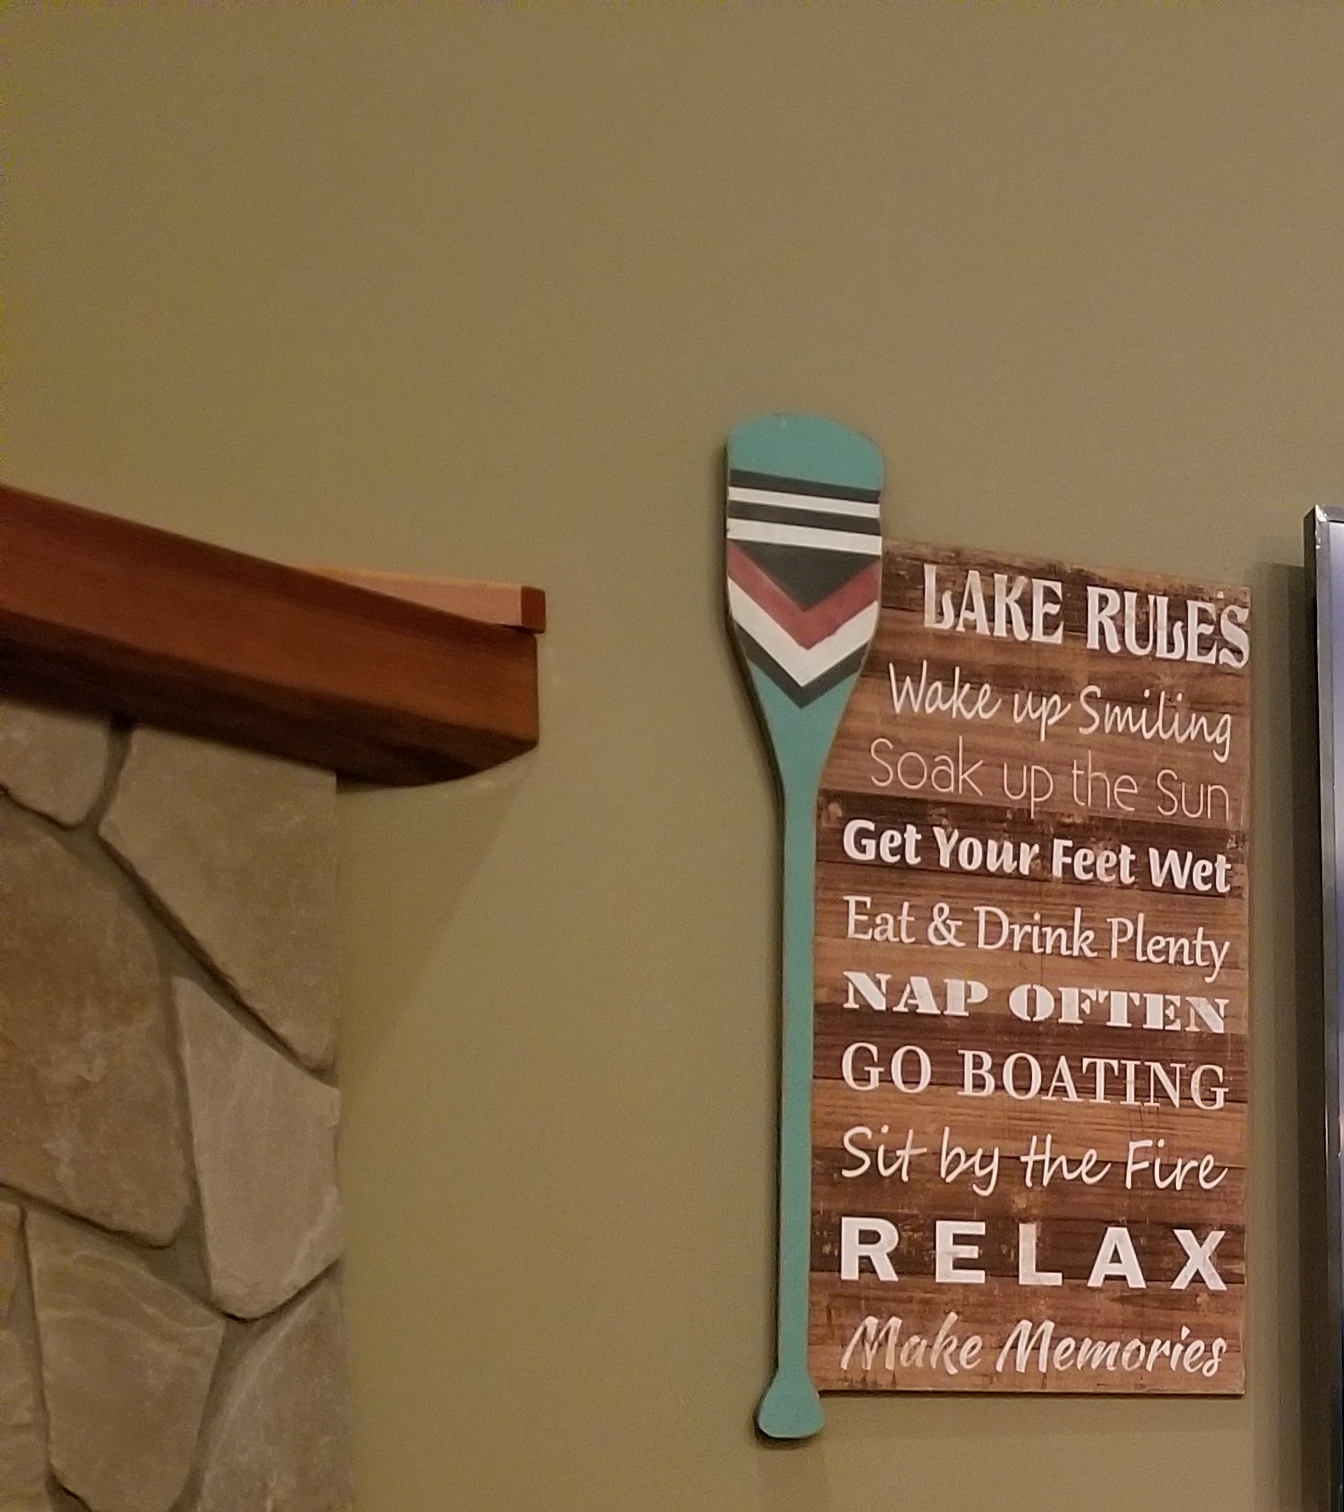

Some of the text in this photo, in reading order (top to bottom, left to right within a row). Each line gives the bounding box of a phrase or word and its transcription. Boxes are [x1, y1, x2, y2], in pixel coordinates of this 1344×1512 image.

[923, 563, 1250, 669] LAKE RULES
[888, 659, 1234, 763] Wake up Smiling
[869, 735, 1231, 822] Soak up the Sun
[842, 819, 1232, 893] Get Your Feet Wet
[842, 895, 1232, 984] Eat & Drink Plenty
[842, 970, 1230, 1034] NAP OFTEN
[841, 1042, 1230, 1111] GO BOATING
[840, 1124, 1231, 1197] Sit by the Fire
[839, 1216, 1228, 1291] RELAX
[840, 1311, 1229, 1378] Make Memories
